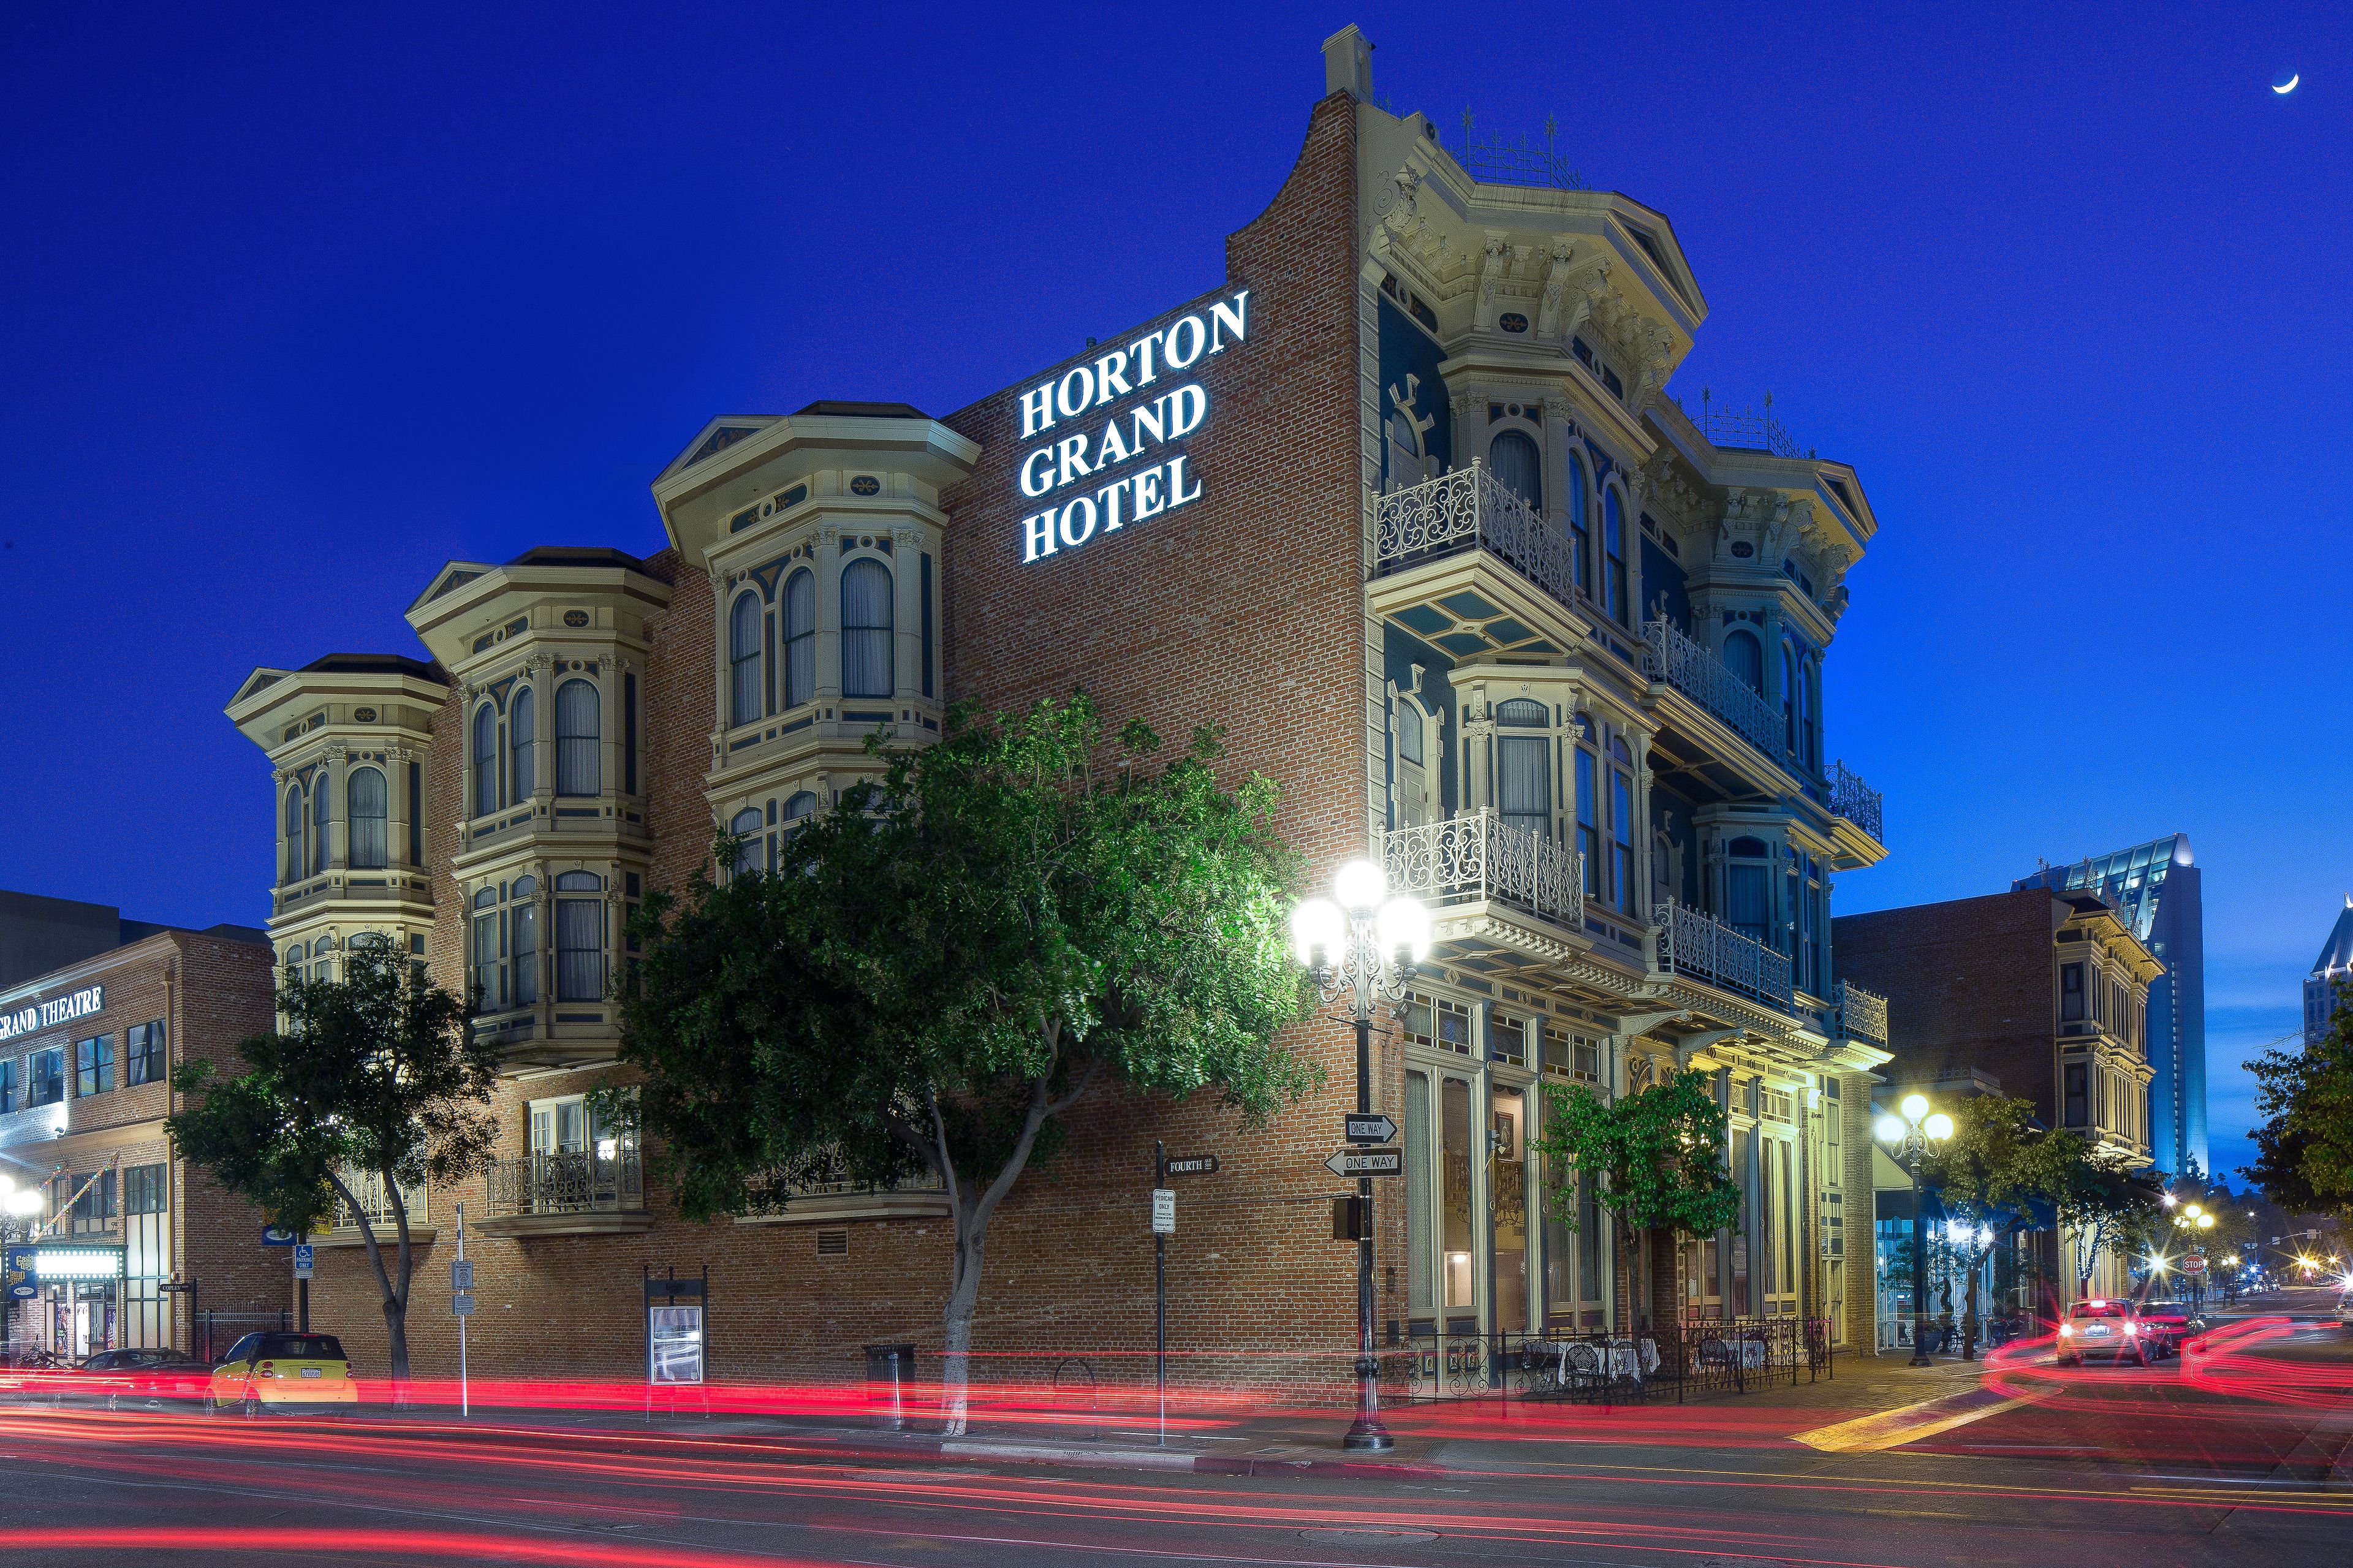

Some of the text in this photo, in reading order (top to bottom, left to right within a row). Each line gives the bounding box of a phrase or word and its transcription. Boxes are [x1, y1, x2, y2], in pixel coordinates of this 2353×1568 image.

[1020, 290, 1249, 441] HORTON
[1020, 384, 1207, 498] GRAND
[1021, 455, 1202, 564] HOTEL
[41, 987, 102, 1026] THEATRE
[1351, 1123, 1382, 1135] ONE WAY
[1170, 1160, 1203, 1172] FOURTH
[1346, 1156, 1395, 1169] ONE WAY
